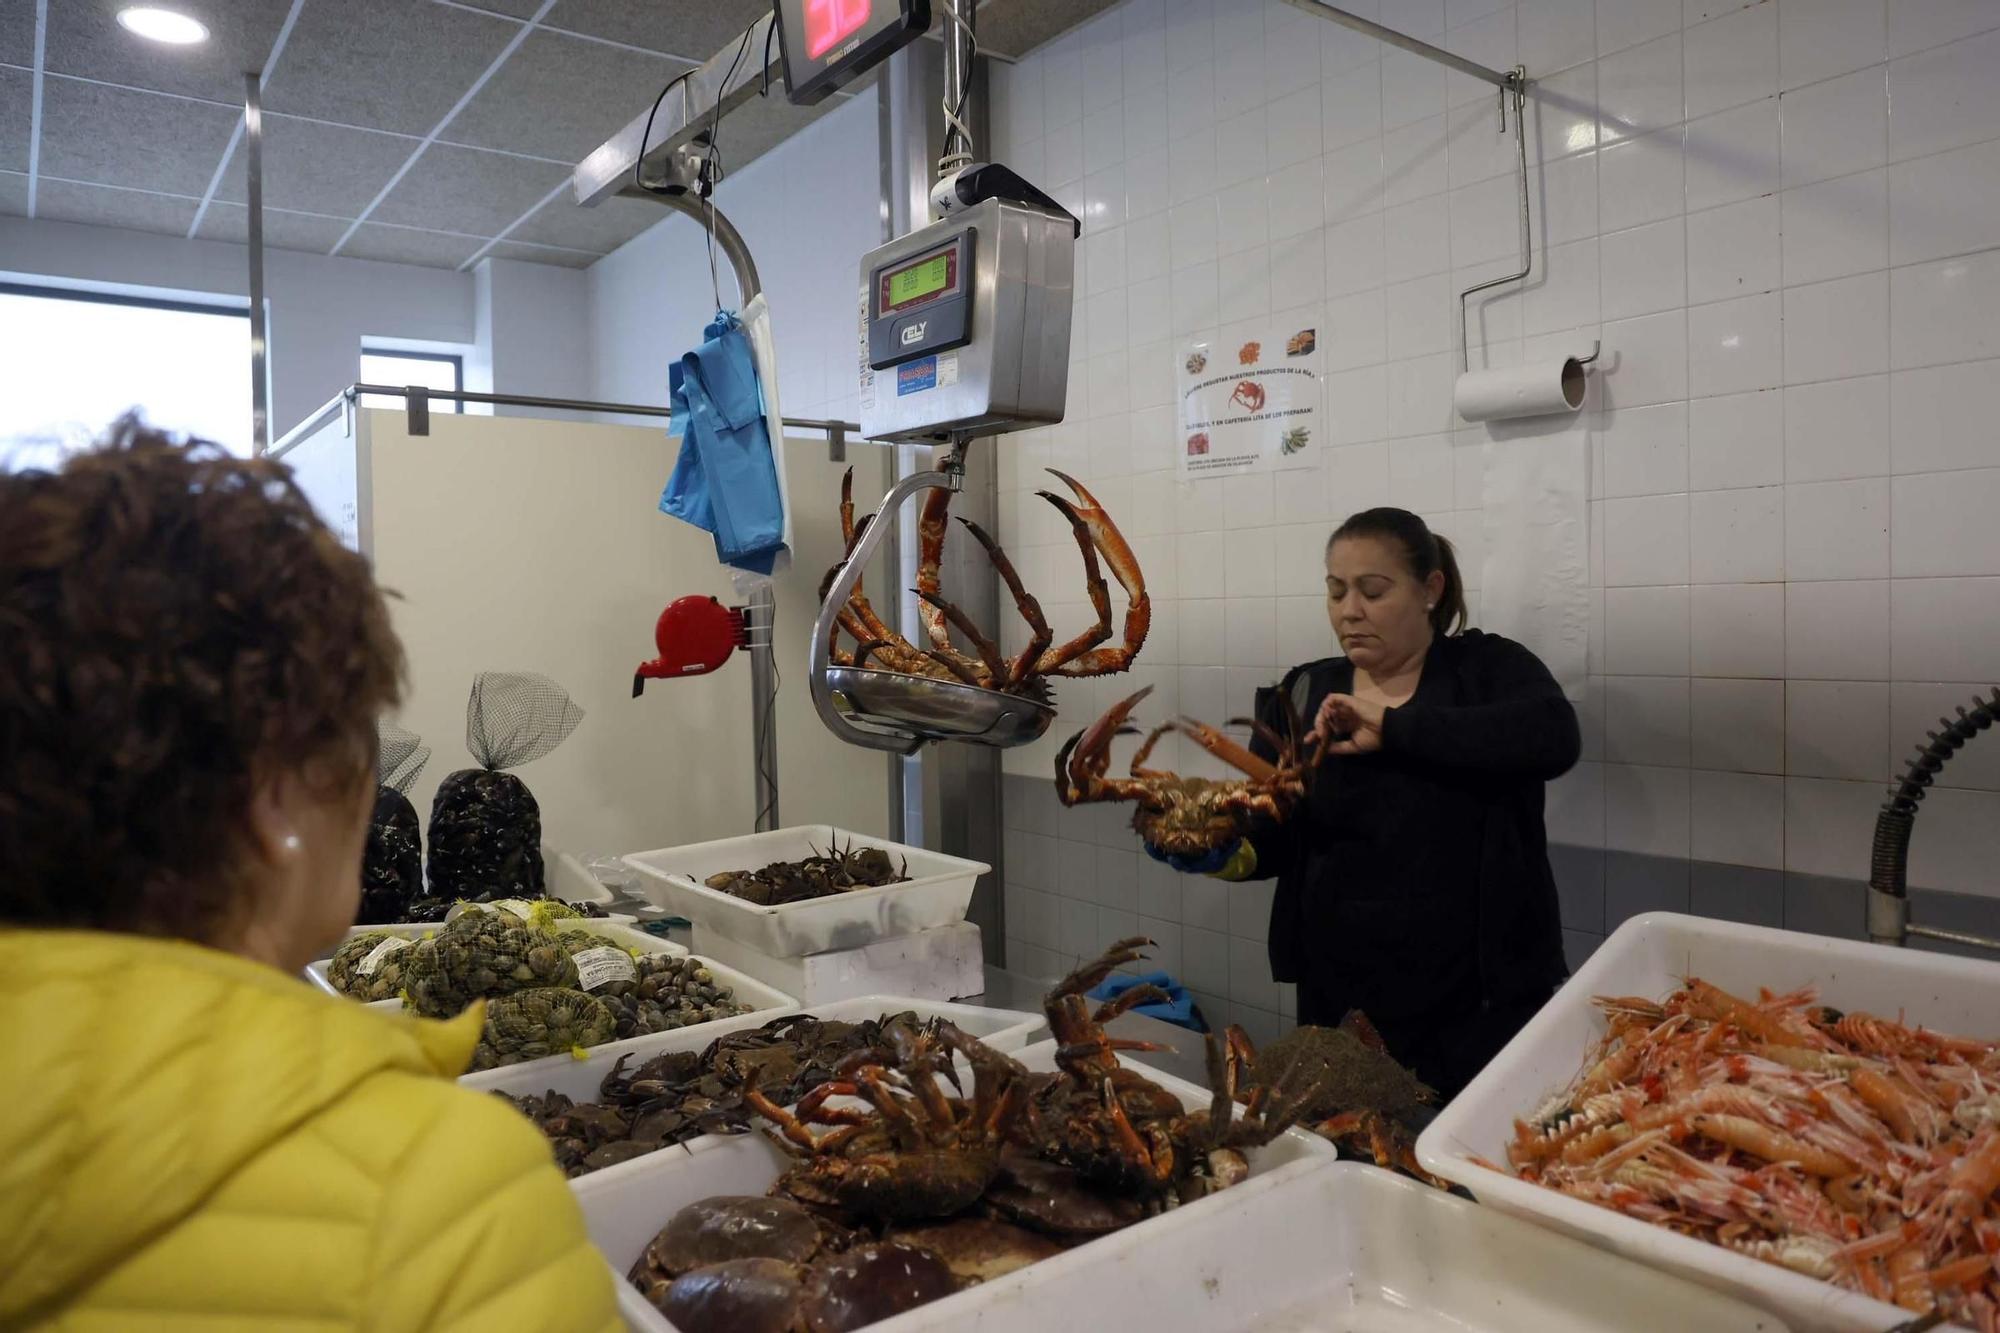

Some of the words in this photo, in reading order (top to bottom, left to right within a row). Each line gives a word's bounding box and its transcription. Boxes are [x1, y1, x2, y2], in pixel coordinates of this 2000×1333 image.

[902, 321, 927, 345] CELY
[1203, 377, 1228, 387] DEGUSTAR
[1229, 371, 1255, 380] NUESTROS
[1256, 367, 1286, 375] PRODUCTOS
[1224, 416, 1252, 425] CAFETERÍA
